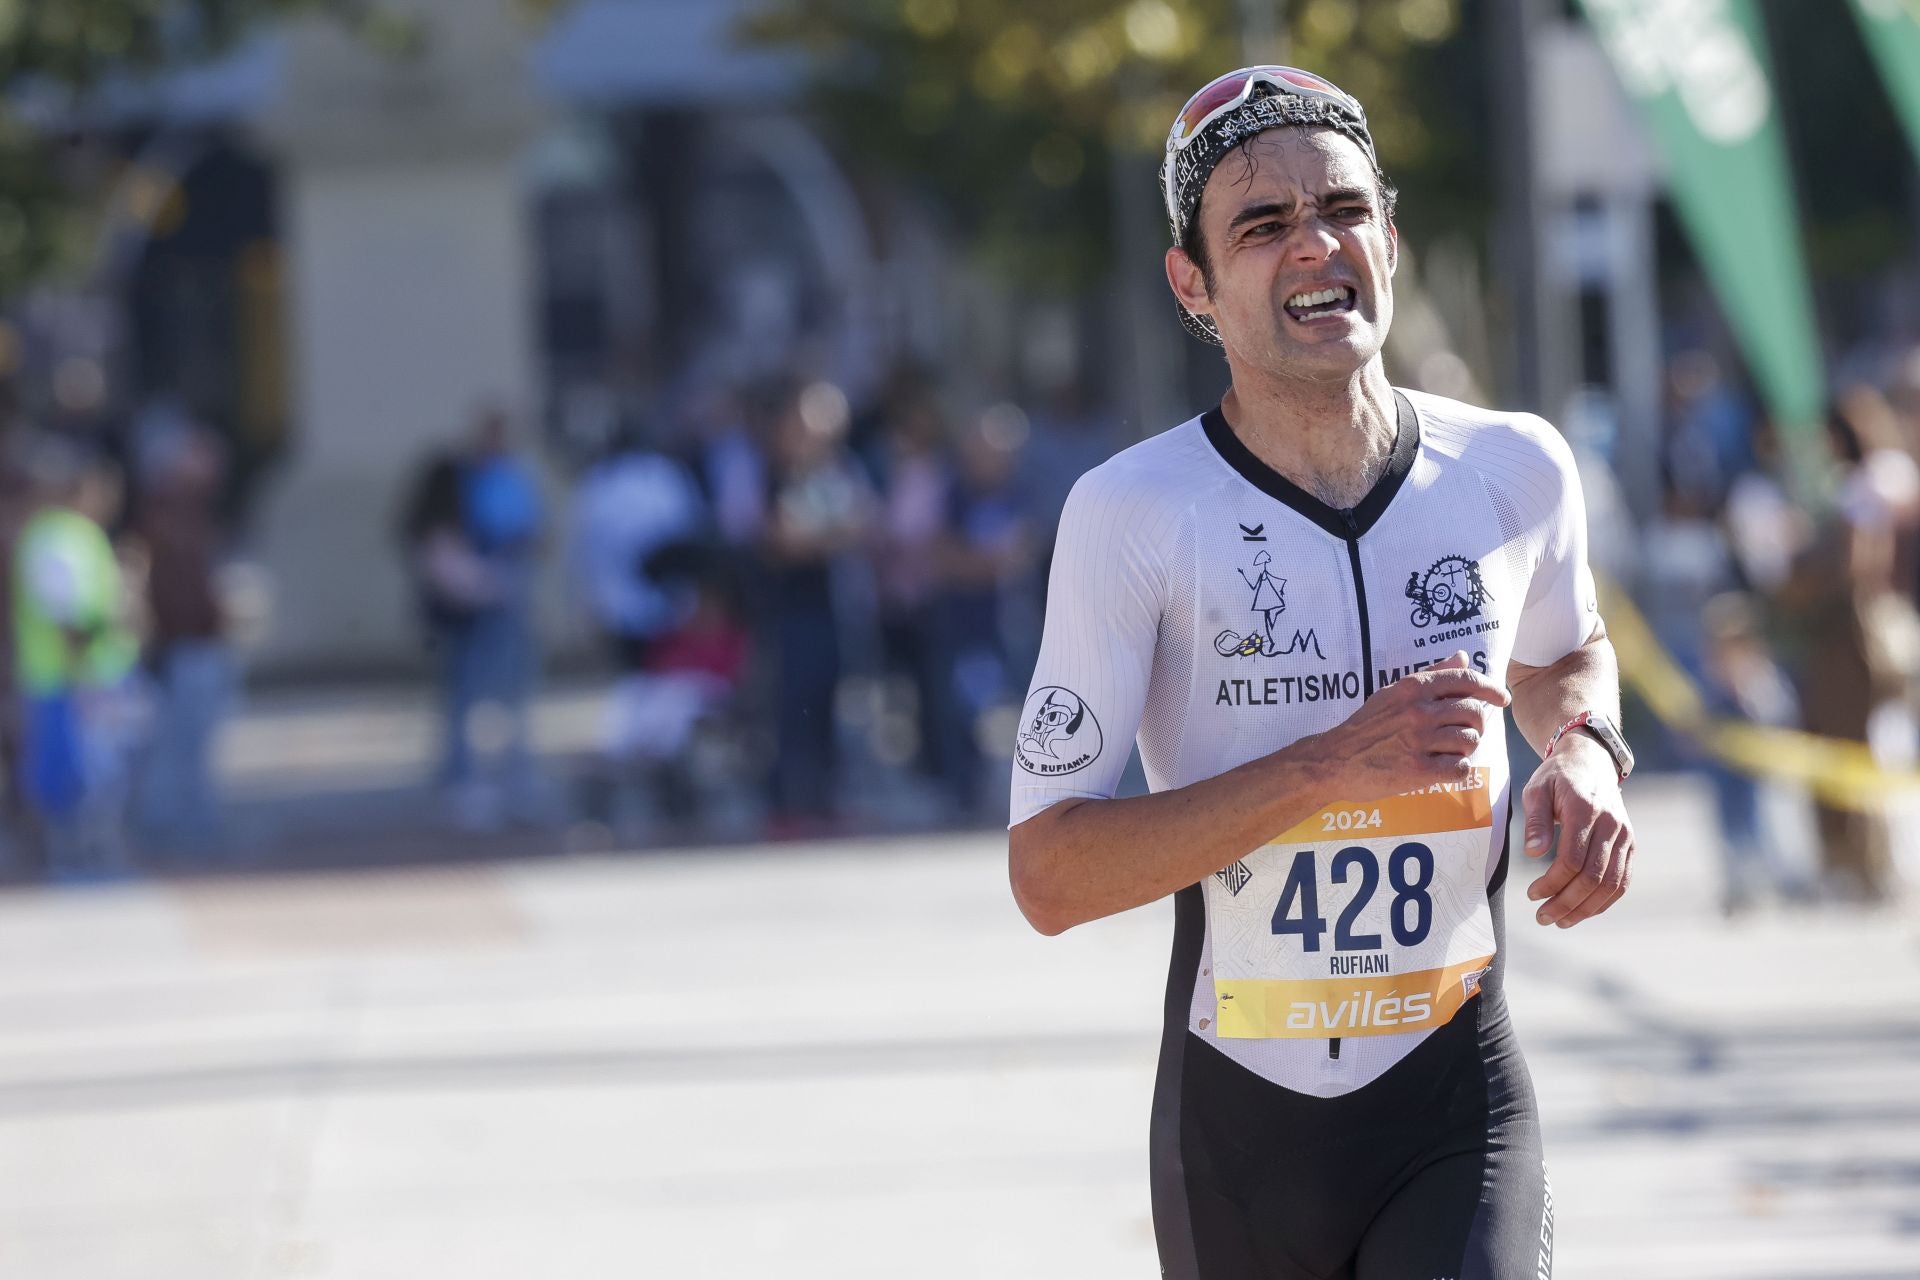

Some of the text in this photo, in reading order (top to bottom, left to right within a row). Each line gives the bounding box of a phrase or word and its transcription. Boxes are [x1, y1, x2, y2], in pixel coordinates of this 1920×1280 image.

[1413, 619, 1500, 649] LA CUENCA BIKES
[1216, 671, 1360, 706] ATLETISMO
[1321, 808, 1383, 832] 2024
[1270, 842, 1435, 953] 428
[1329, 953, 1390, 976] RUFIANI
[1286, 988, 1431, 1030] avilés
